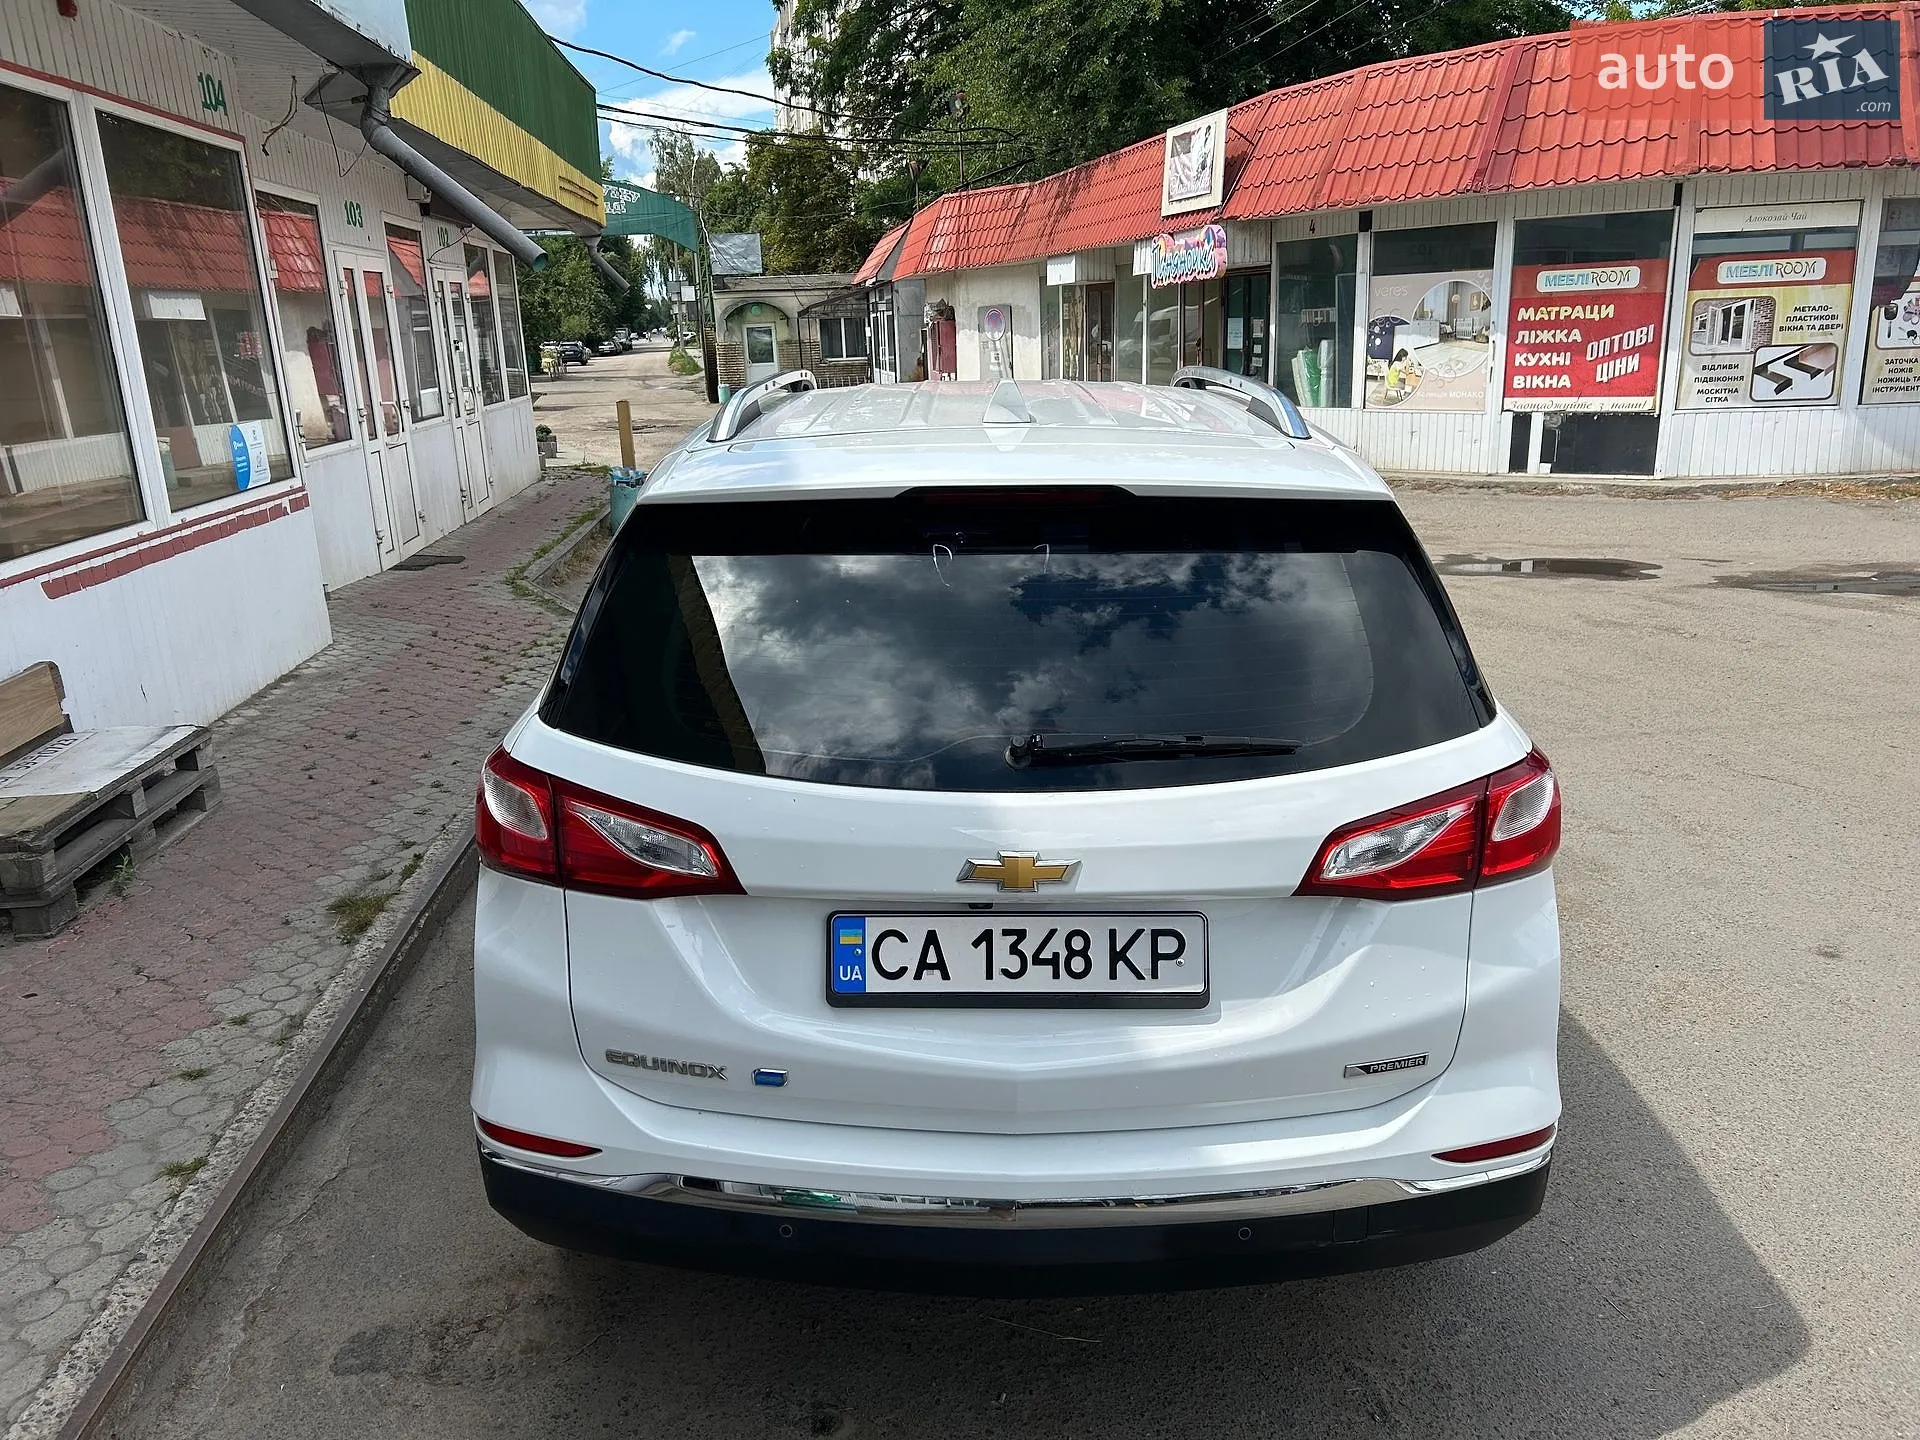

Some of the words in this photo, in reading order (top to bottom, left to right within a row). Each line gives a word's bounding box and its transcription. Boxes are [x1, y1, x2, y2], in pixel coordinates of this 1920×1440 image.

[198, 71, 228, 116] 104
[344, 200, 363, 228] 103
[1309, 219, 1316, 234] 4
[1375, 284, 1408, 297] veres
[1517, 304, 1615, 322] МАТРАЦИ
[1793, 305, 1833, 313] МЕТАЛО-
[1785, 314, 1839, 322] ПЛАСТИКОВІ
[1818, 323, 1844, 331] ДВЕРІ
[1515, 328, 1582, 344] ЛІЖКА
[1586, 324, 1655, 361] ОПТОВІ
[1514, 352, 1571, 367] КУХНІ
[1701, 363, 1740, 371] ВІДЛИВИ
[1595, 353, 1640, 383] ЦІНИ
[1512, 374, 1571, 389] ВІКНА
[1694, 375, 1745, 384] ПІДВІКОННЯ
[1877, 376, 1911, 384] НОЖИЦЬ
[1449, 391, 1484, 399] МОНАКО
[840, 966, 862, 981] UA
[871, 928, 951, 981] CA
[971, 928, 1093, 981] 1348
[1108, 928, 1187, 981] KP
[605, 1048, 728, 1081] EQUINOX
[1369, 1057, 1425, 1073] PREMIER
